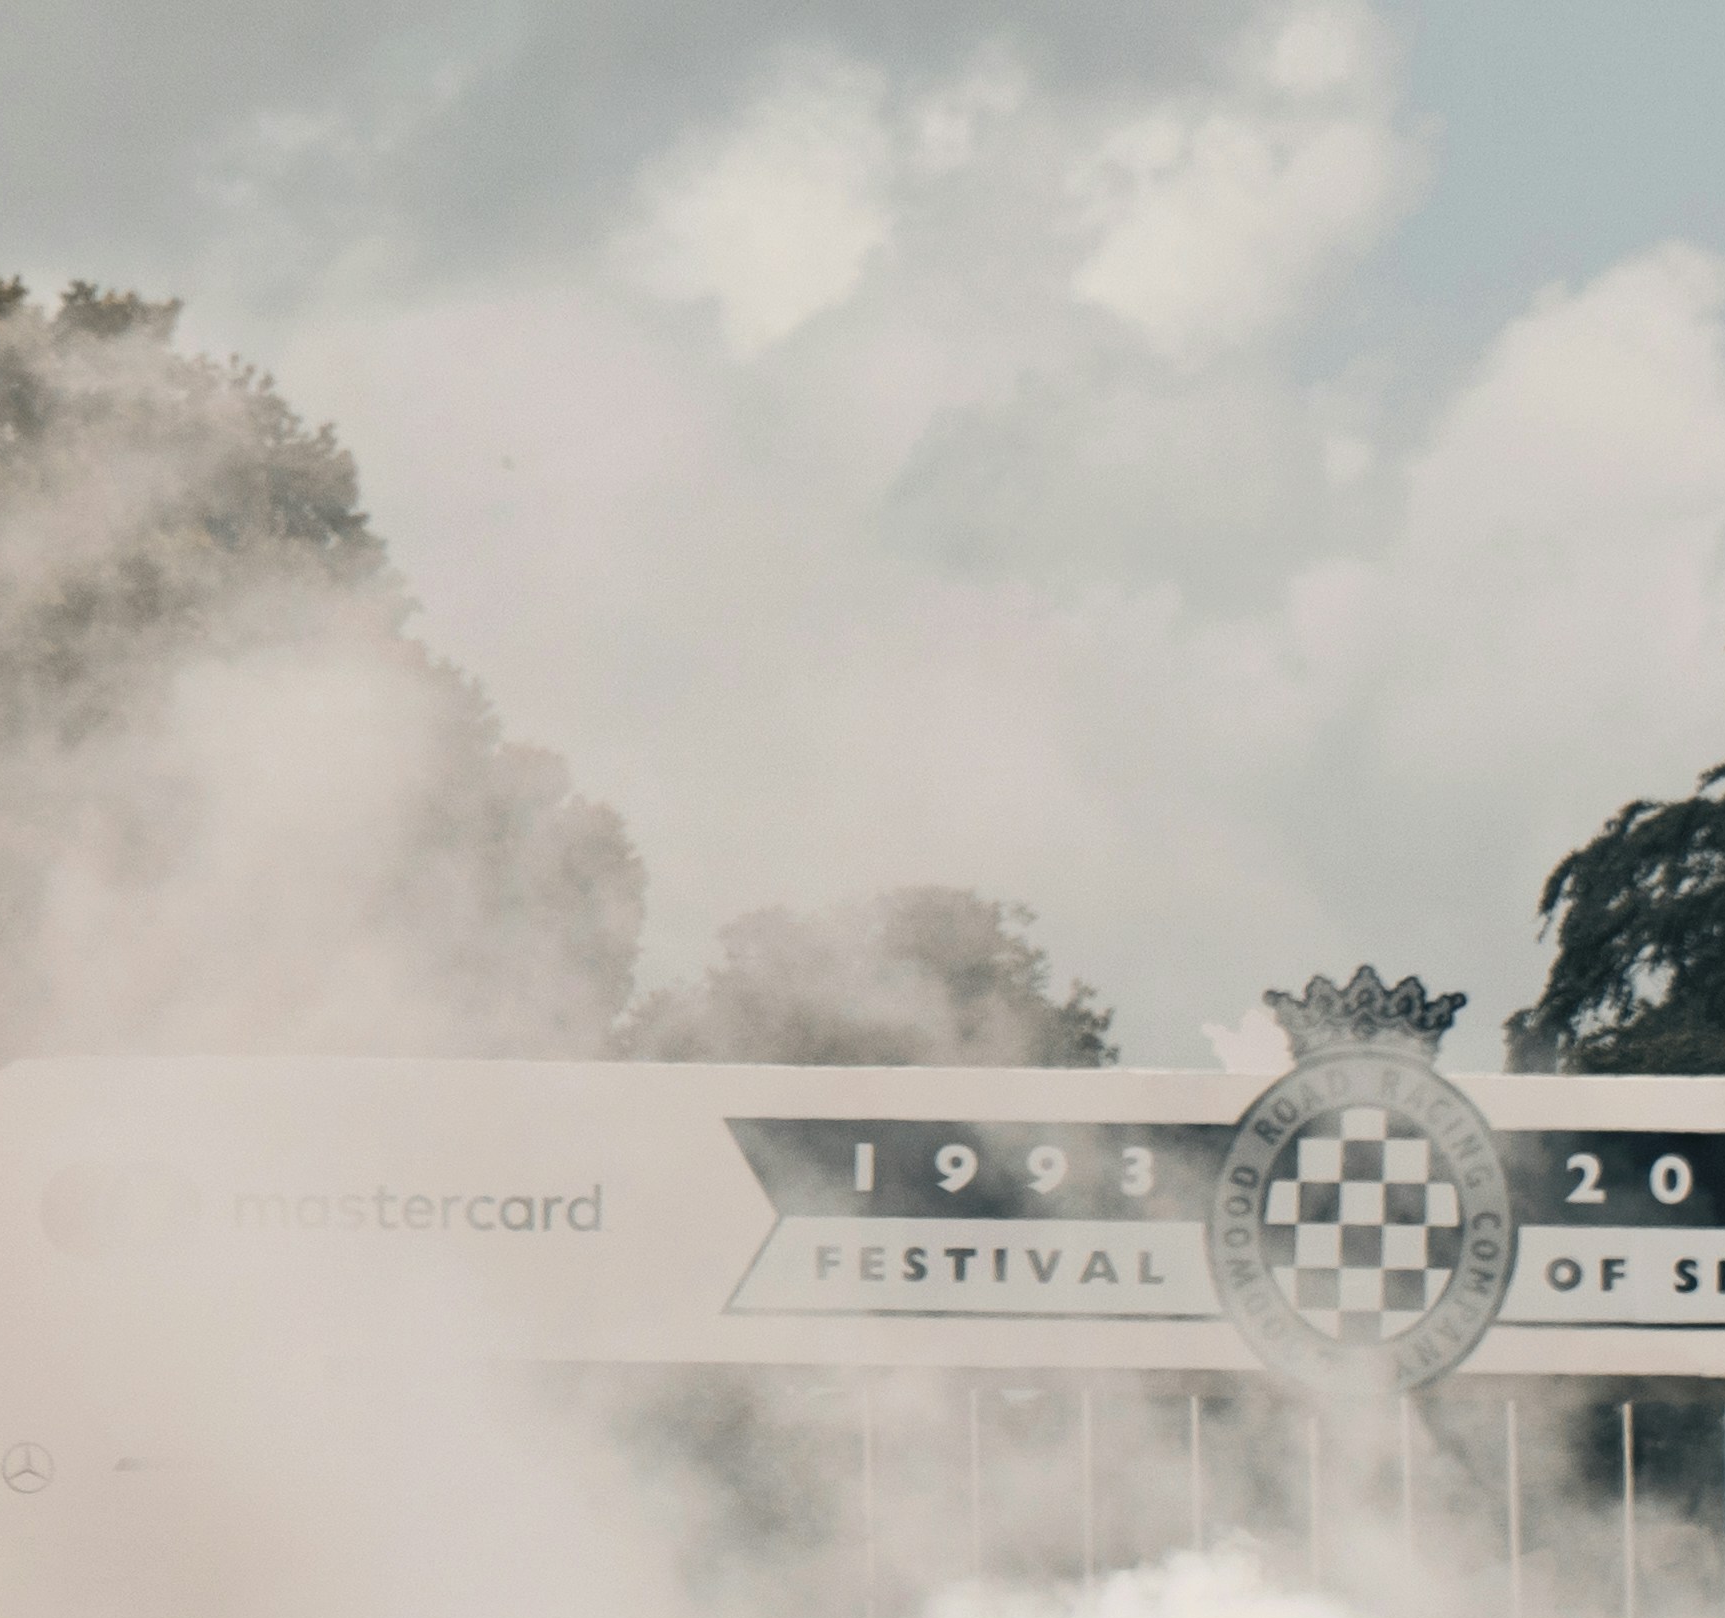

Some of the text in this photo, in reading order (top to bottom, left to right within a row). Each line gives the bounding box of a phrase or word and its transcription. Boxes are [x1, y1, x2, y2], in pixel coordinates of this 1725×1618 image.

[855, 1142, 1156, 1195] 1993
[232, 1183, 603, 1233] mastercard
[815, 1245, 1165, 1286] FESTIVAL
[1545, 1257, 1629, 1292] OF
